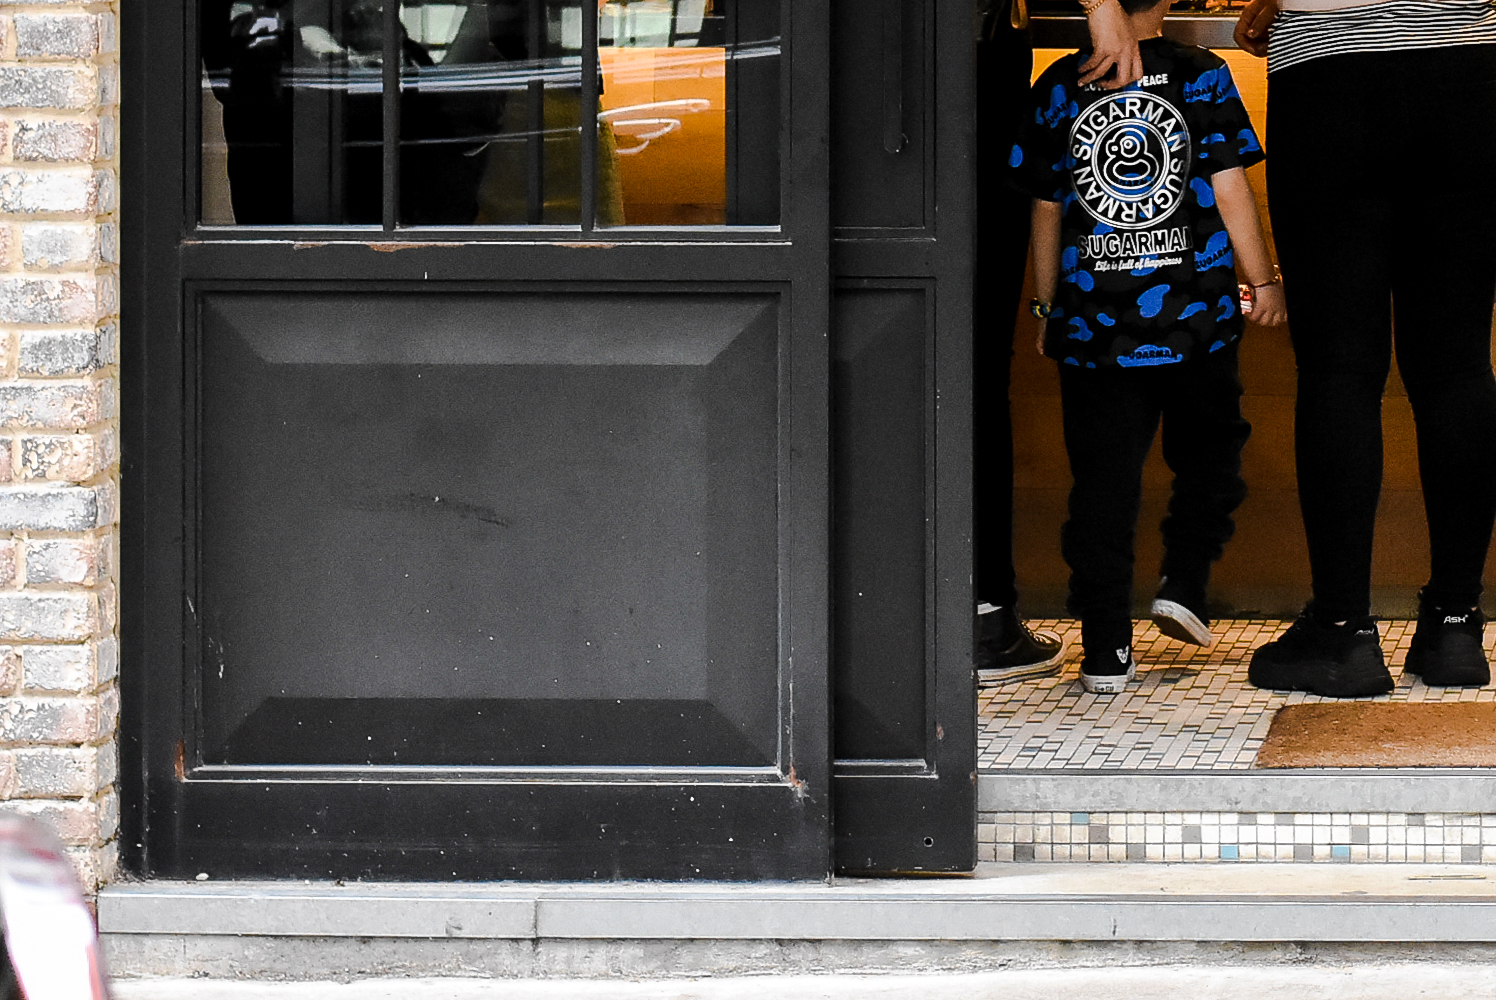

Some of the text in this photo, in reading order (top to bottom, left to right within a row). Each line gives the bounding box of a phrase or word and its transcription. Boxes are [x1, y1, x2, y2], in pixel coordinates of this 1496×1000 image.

[1137, 73, 1169, 88] PEACE
[1072, 98, 1186, 160] SUGARMAN
[1443, 615, 1467, 624] ASH
